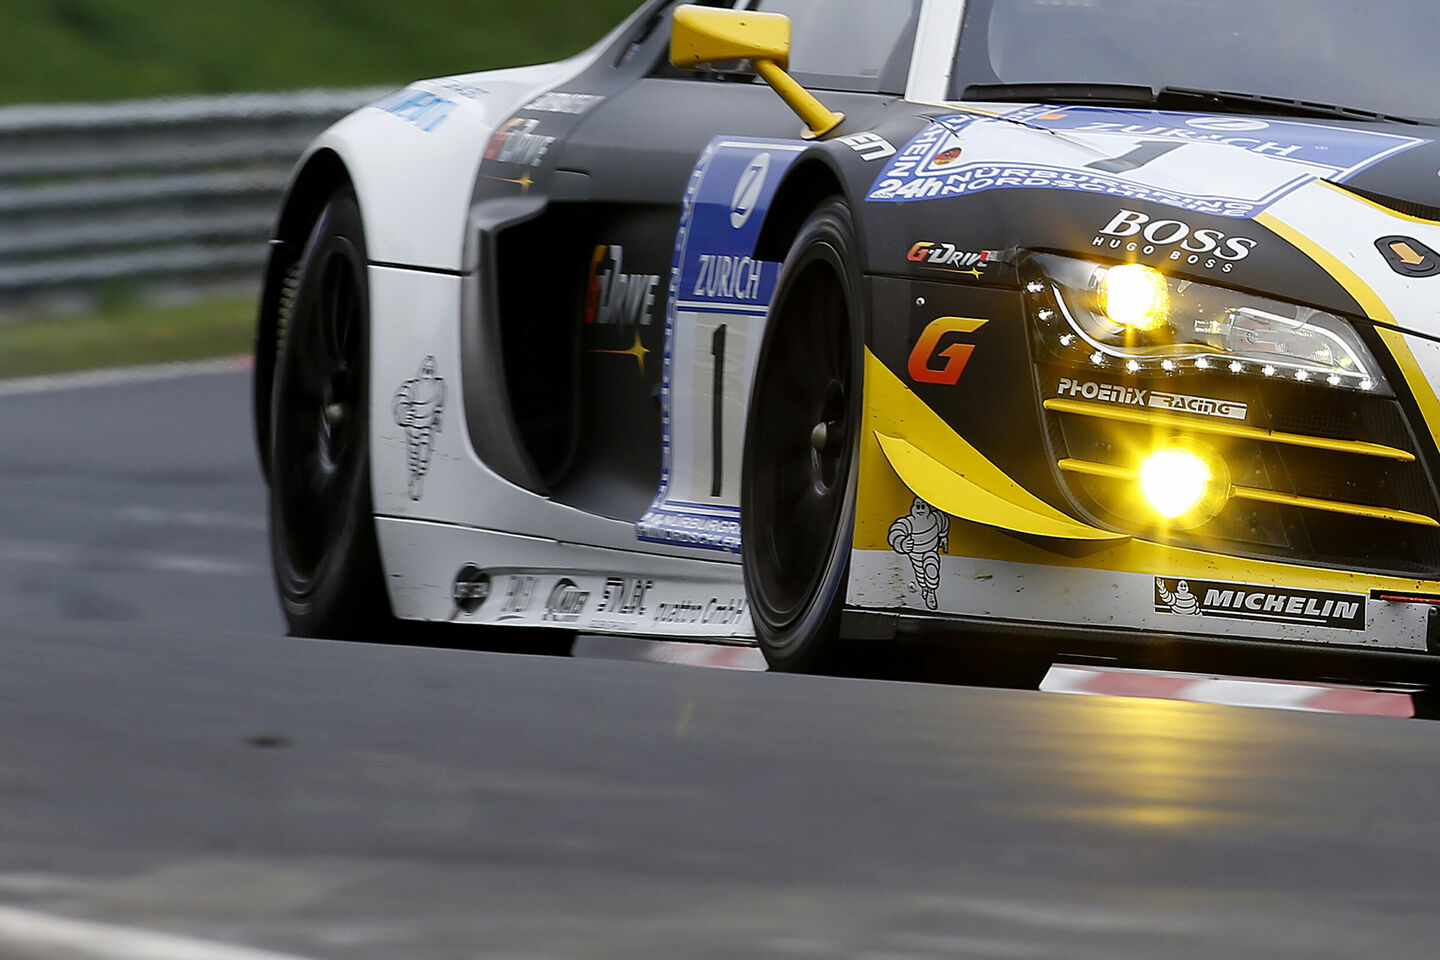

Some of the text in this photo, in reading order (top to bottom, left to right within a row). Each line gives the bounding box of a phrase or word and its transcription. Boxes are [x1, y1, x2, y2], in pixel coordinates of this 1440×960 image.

[1074, 121, 1303, 158] ZURICH
[869, 178, 947, 199] 24h
[941, 177, 1249, 218] NORDSCHLEIFE
[1092, 236, 1234, 273] HUGO BOSS
[1098, 208, 1258, 262] BOSS
[693, 253, 763, 300] ZURICH
[908, 316, 990, 385] G
[711, 323, 727, 498] 1
[1203, 588, 1360, 620] MICHELIN
